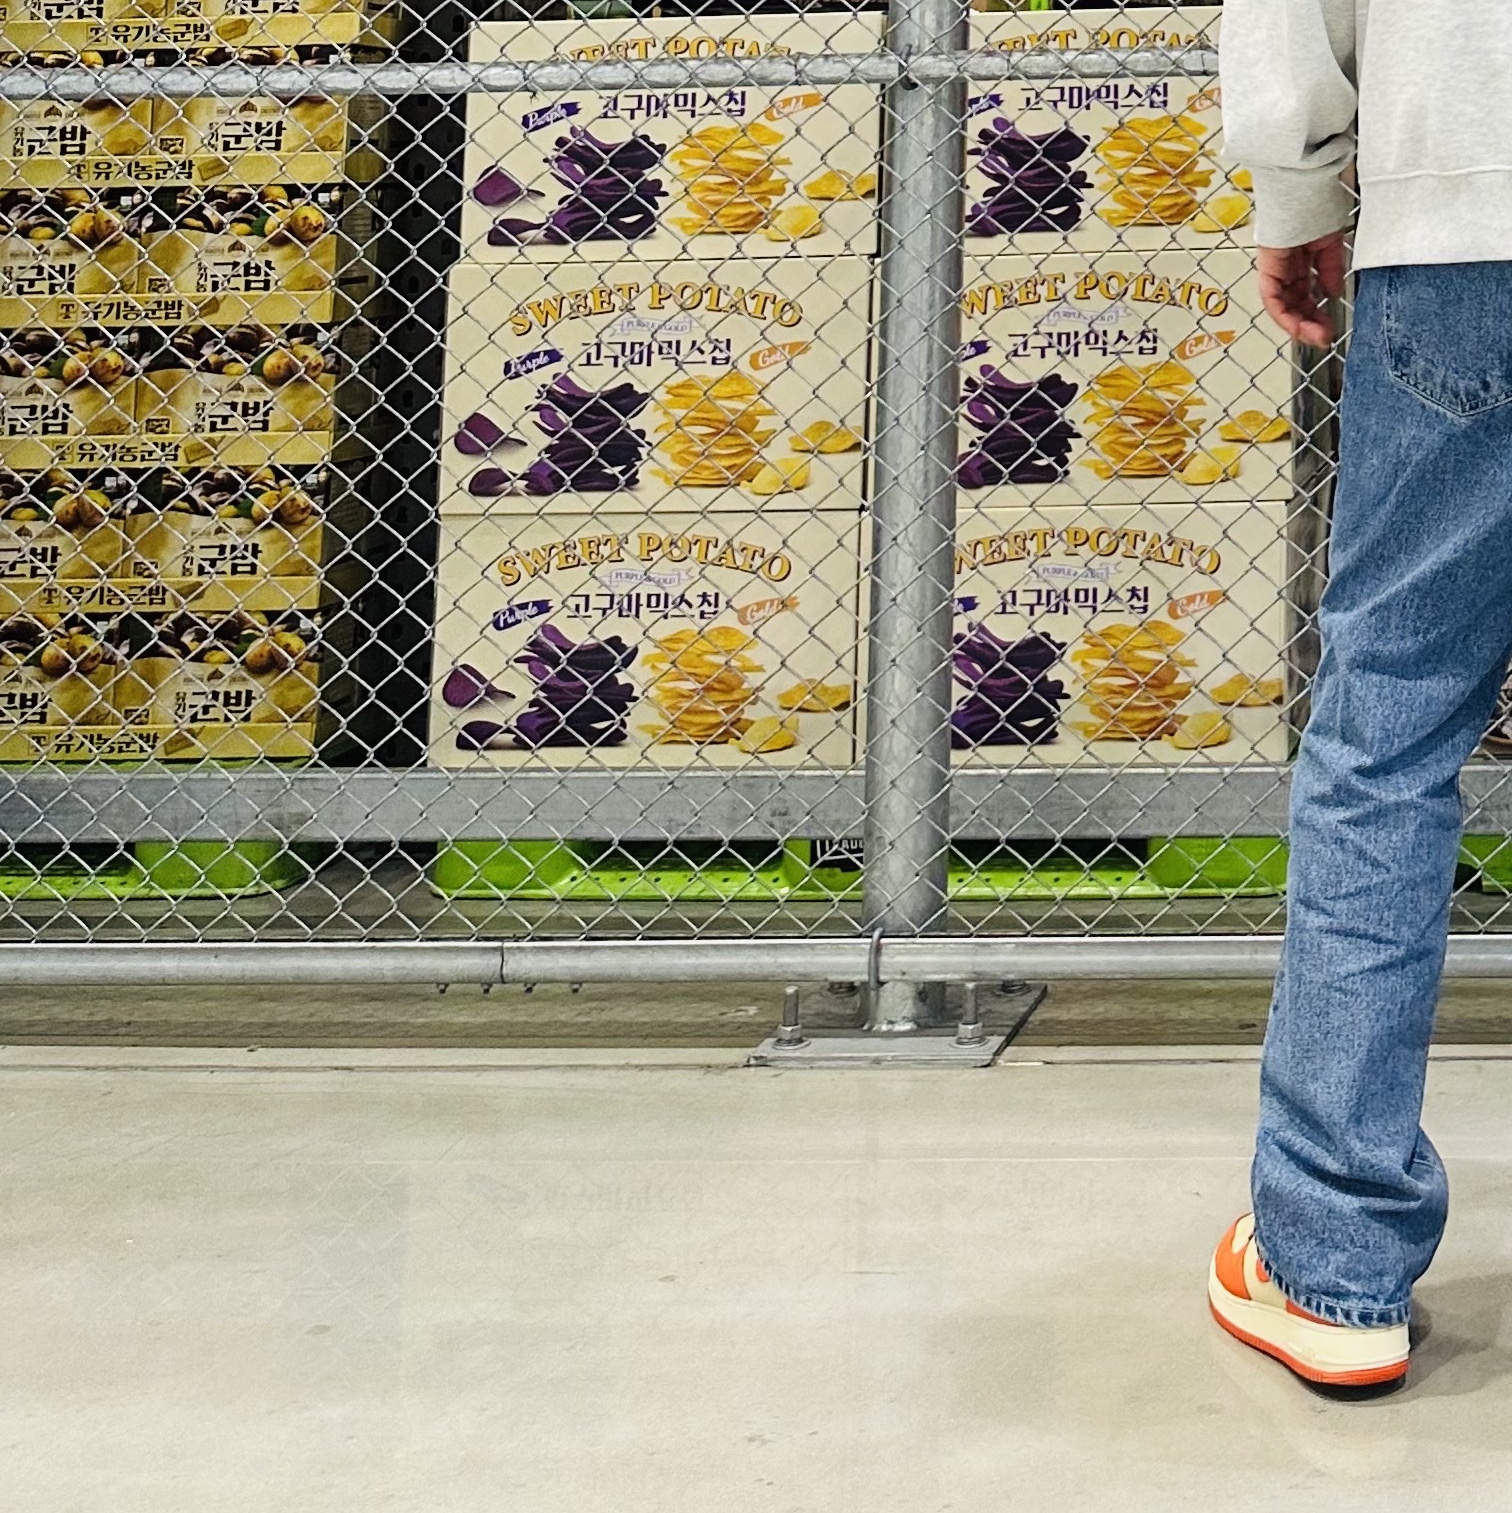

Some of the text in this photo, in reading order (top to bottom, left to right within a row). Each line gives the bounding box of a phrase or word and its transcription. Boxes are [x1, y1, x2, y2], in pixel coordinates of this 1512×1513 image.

[27, 125, 92, 157] 군밤
[221, 120, 287, 152] 군밤
[211, 259, 276, 292] 군밤
[83, 300, 184, 320] 유기농군밤
[508, 281, 805, 336] SWEET POTATO
[960, 270, 1230, 319] WEET POTATO
[9, 402, 74, 436] 군밤
[209, 399, 274, 432] 군밤
[198, 542, 263, 576] 군밤
[498, 532, 793, 586] SWEET POTATO
[954, 526, 1221, 575] WEET POTATO
[565, 591, 721, 619] 고구마믹스칩
[994, 585, 1150, 616] 고구마믹스칩
